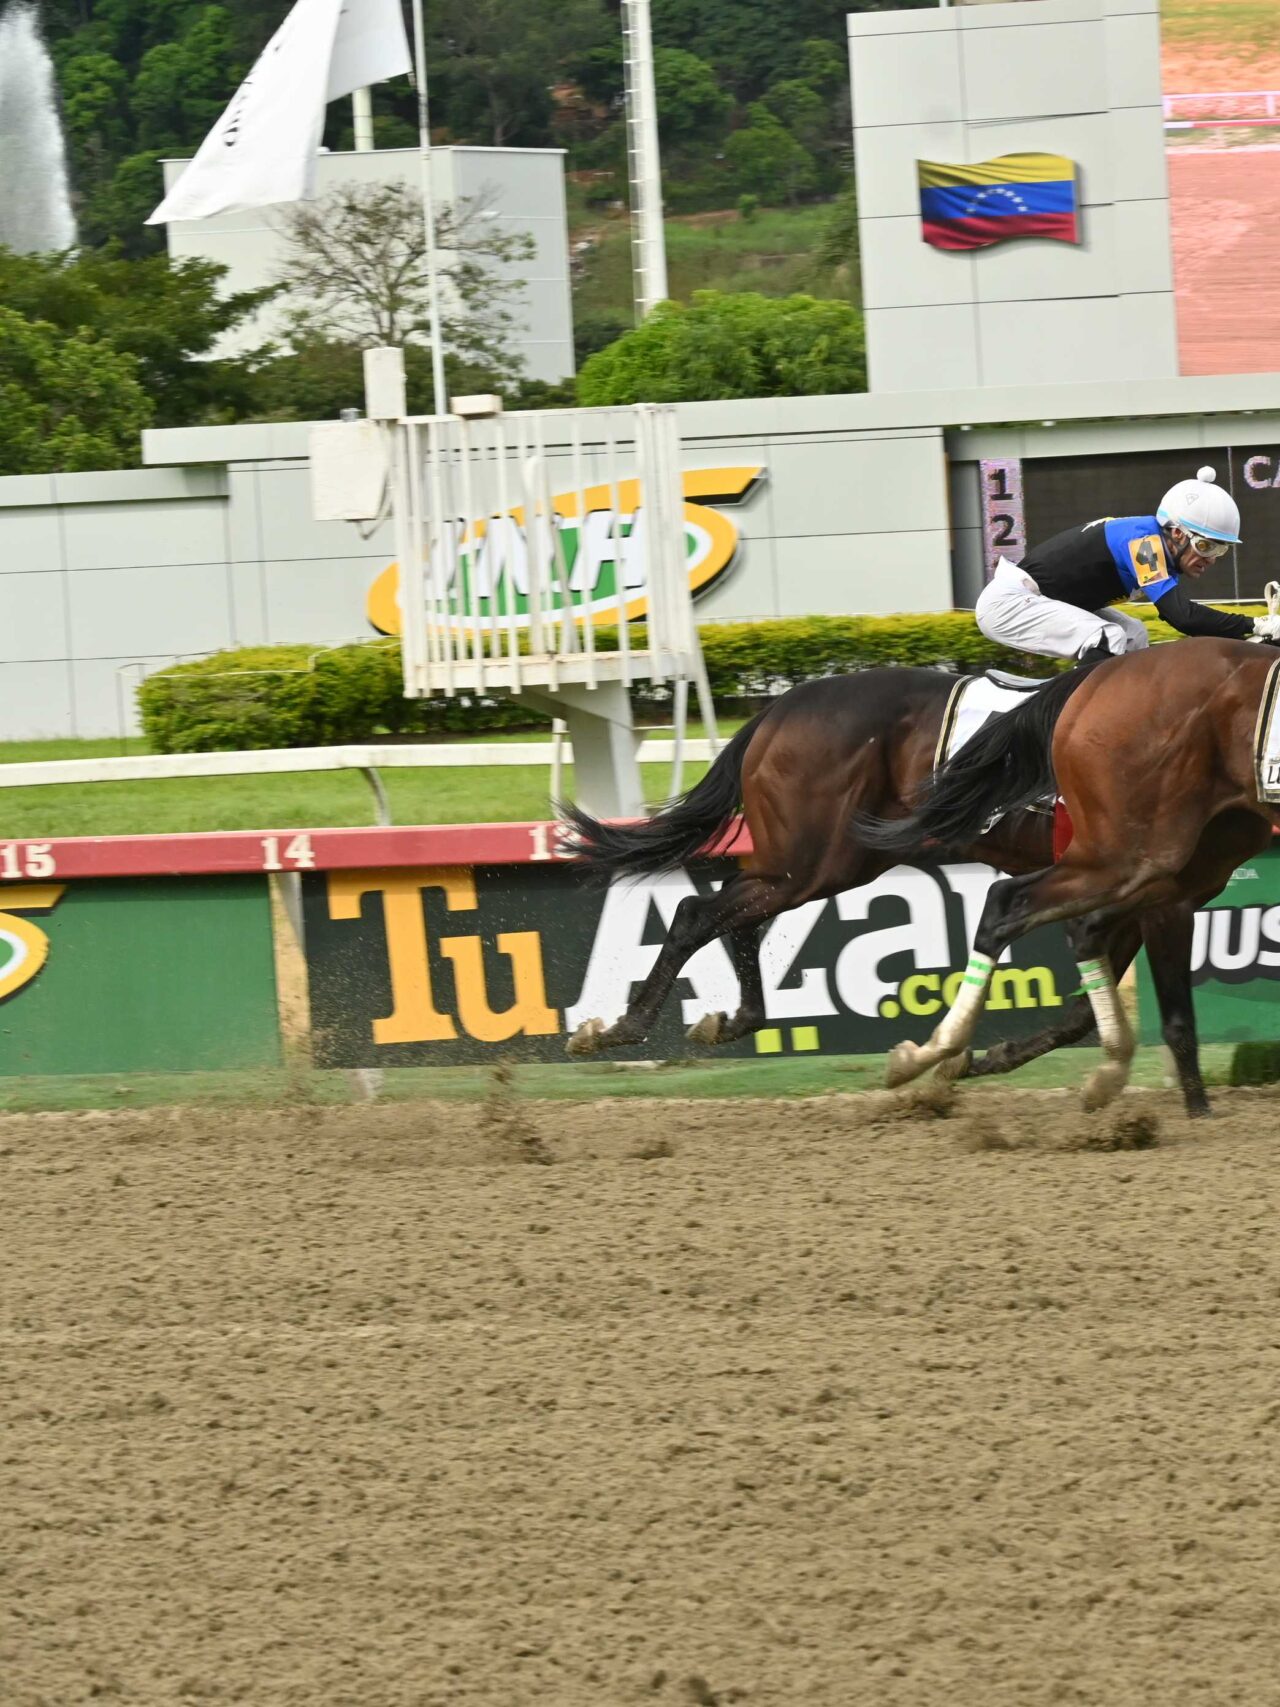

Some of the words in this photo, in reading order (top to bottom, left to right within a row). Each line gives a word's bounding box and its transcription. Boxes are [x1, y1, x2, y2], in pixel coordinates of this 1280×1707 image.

[988, 468, 1013, 501] 1
[991, 513, 1018, 547] 2
[1136, 538, 1159, 572] 4
[0, 843, 56, 878] 15
[261, 834, 316, 870] 14
